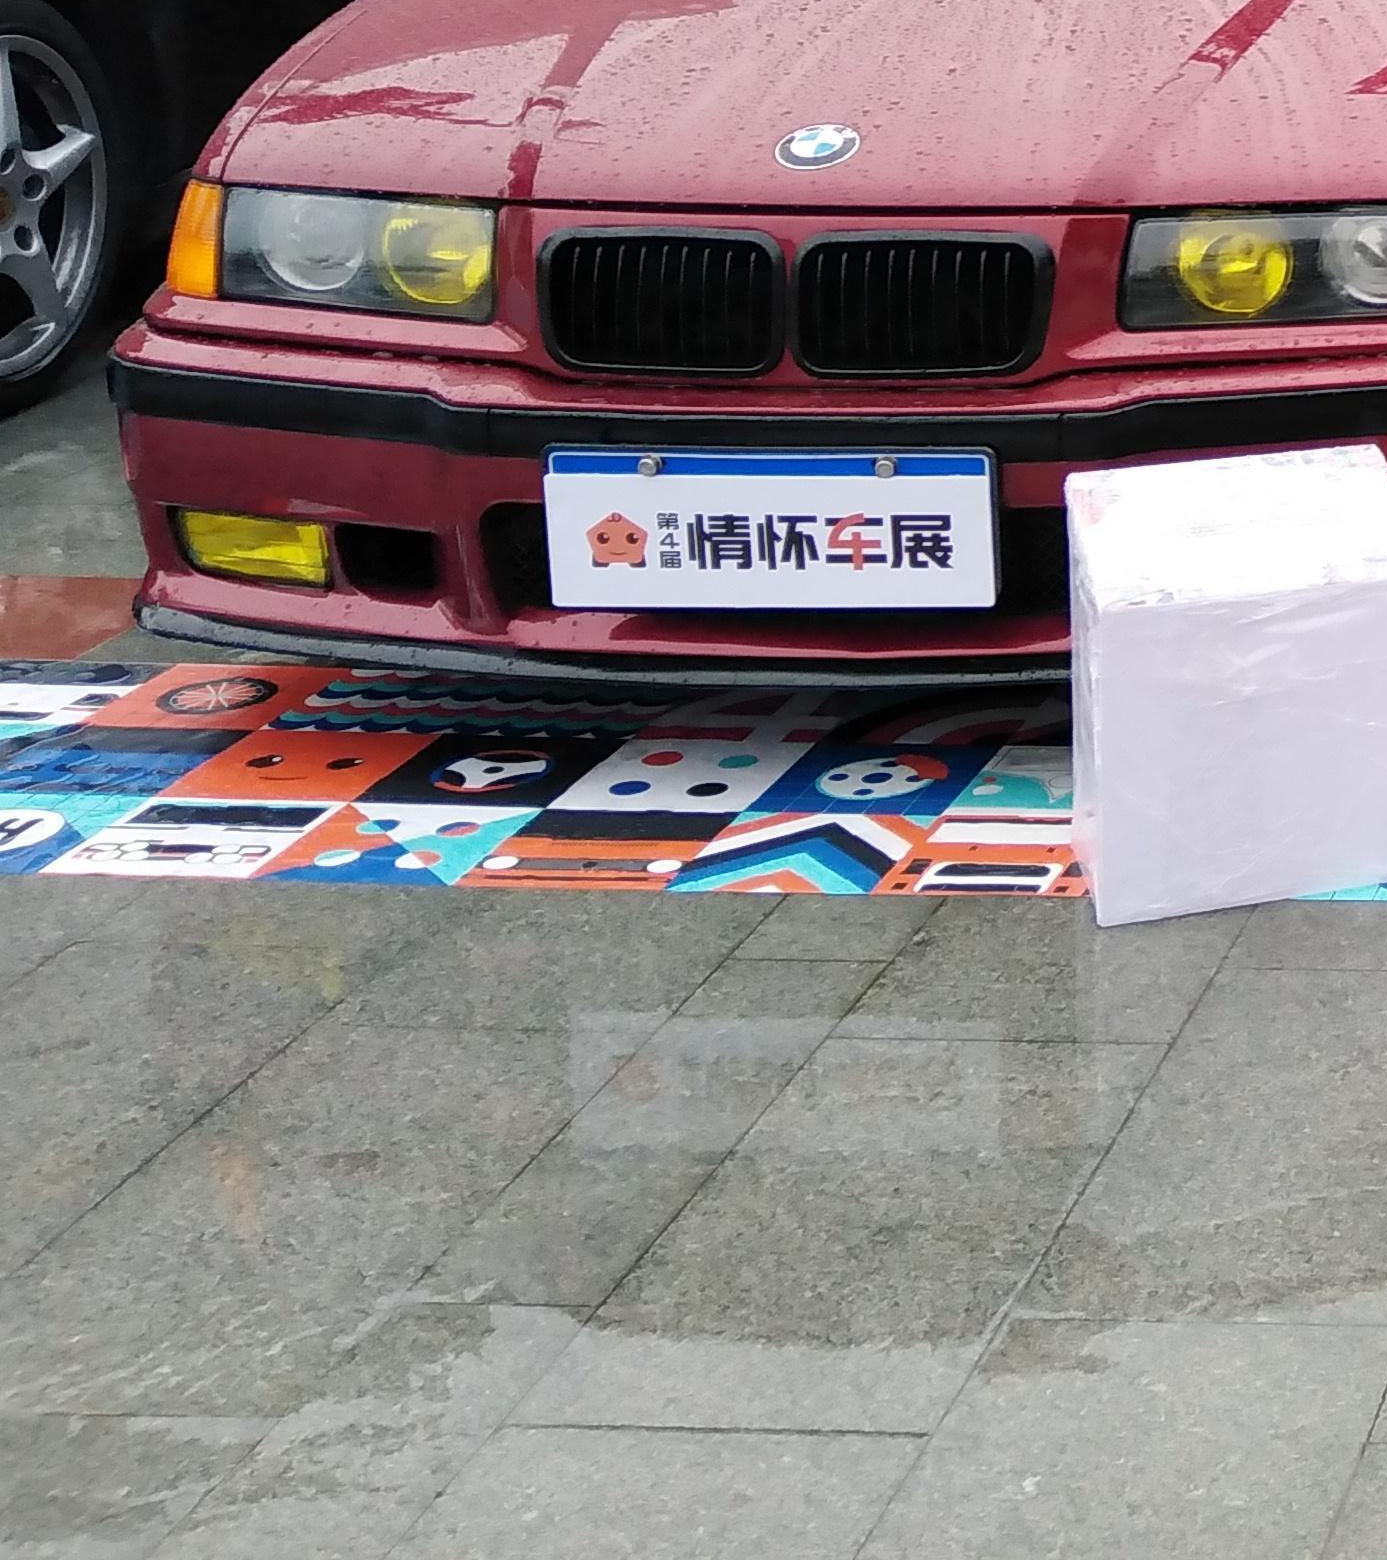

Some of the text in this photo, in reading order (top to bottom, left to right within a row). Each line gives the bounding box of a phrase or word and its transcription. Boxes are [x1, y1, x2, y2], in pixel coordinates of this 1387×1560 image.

[655, 511, 683, 570] 第4届
[686, 512, 954, 571] 情怀车展
